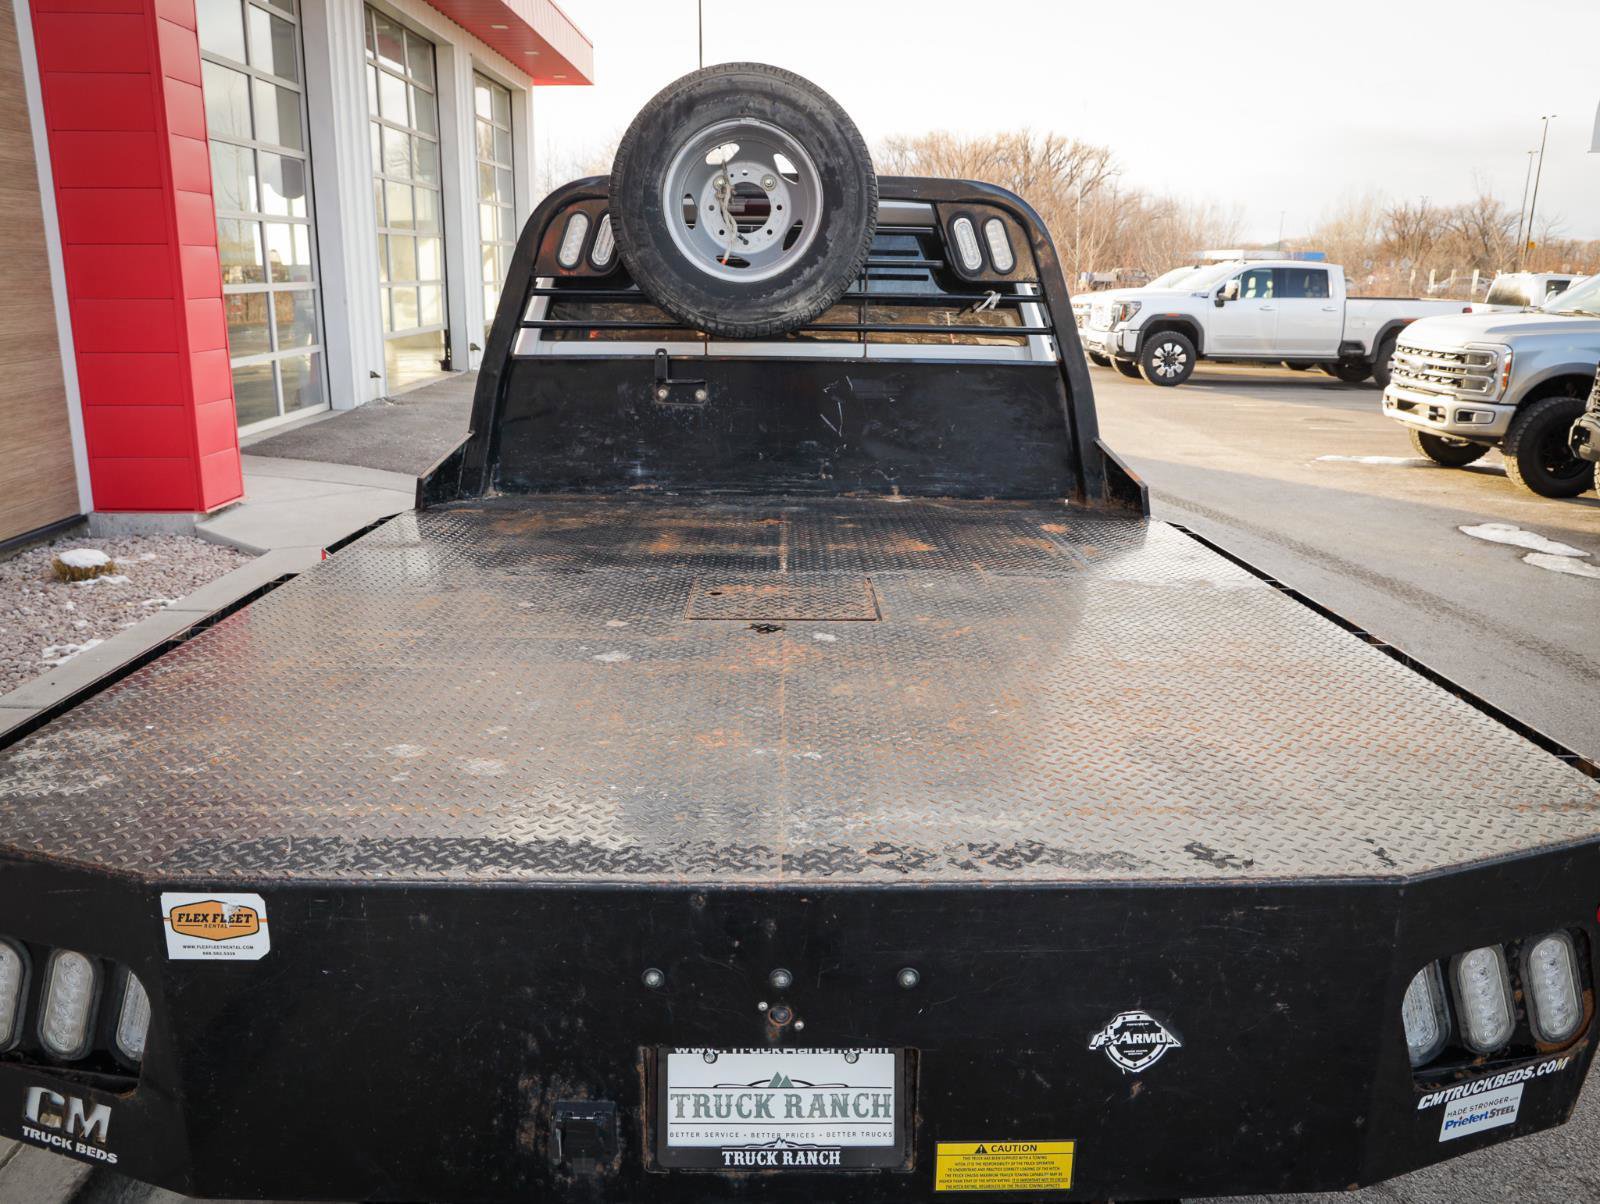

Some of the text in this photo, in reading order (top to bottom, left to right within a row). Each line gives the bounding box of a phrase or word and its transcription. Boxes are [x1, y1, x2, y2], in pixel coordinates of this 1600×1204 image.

[177, 913, 252, 924] FLEX FLEET
[1417, 1056, 1570, 1110] CMTRUCKBEDS.COM
[25, 1086, 112, 1144] CM
[670, 1092, 892, 1118] TRUCK RANCH
[1447, 1096, 1509, 1118] MADE STRONGER
[22, 1126, 118, 1164] TRUCK BEDS
[722, 1150, 840, 1166] TRUCK RANCH
